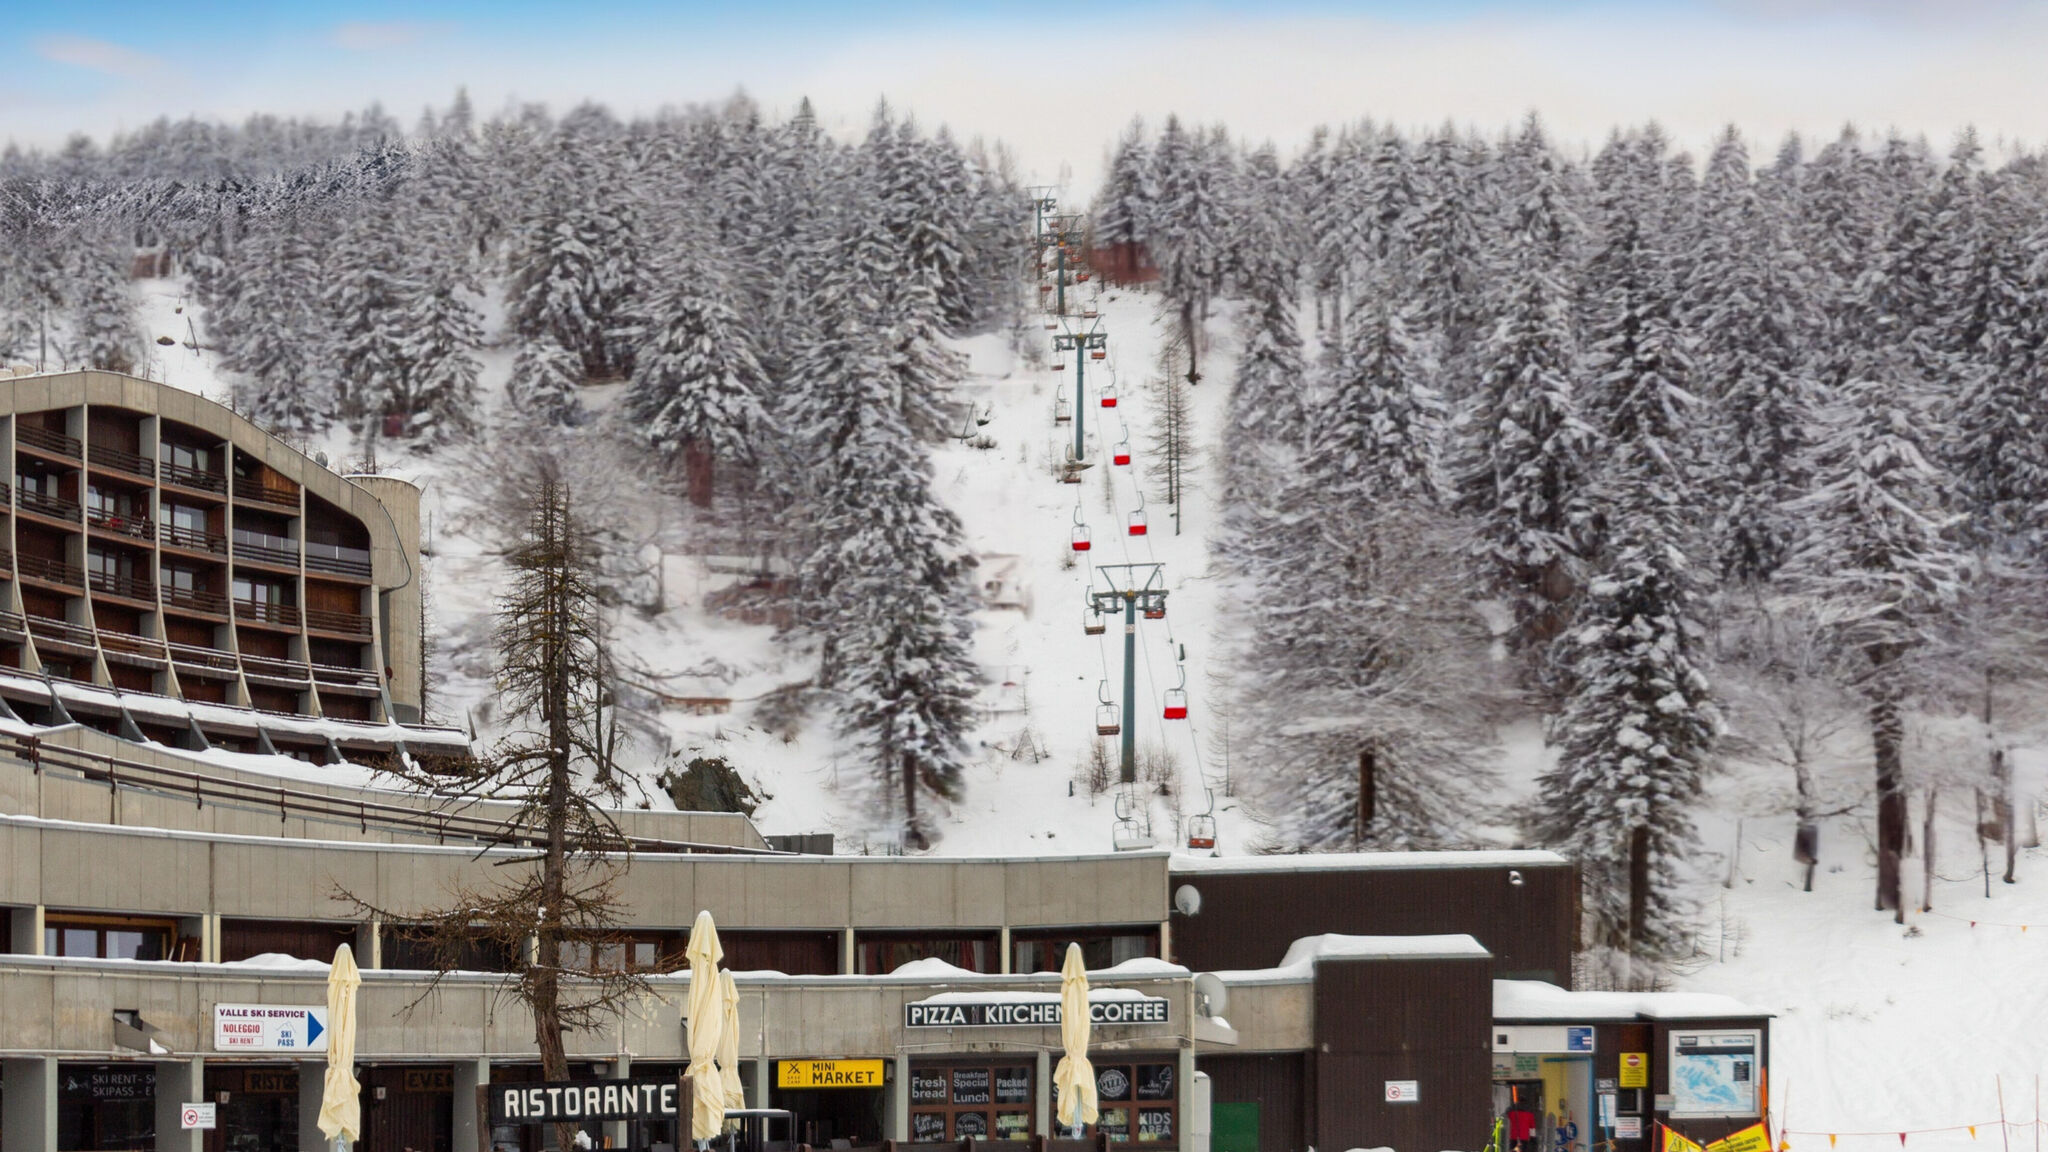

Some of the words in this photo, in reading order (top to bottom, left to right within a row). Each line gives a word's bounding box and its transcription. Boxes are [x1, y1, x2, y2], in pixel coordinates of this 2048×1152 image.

[219, 1009, 248, 1017] VALLE
[250, 1009, 266, 1017] SKI
[267, 1010, 305, 1018] SERVICE
[911, 1006, 966, 1024] PIZZA
[1090, 1003, 1164, 1021] COFFEE
[223, 1023, 260, 1034] NOLEGGIO
[281, 1030, 292, 1038] SKI
[277, 1039, 295, 1047] PASS
[812, 1062, 835, 1071] MINI
[92, 1074, 108, 1084] SKI
[812, 1071, 875, 1084] MARKET
[912, 1075, 947, 1087] Fresh
[996, 1078, 1027, 1087] Packed
[953, 1078, 989, 1088] Special
[92, 1087, 135, 1097] SKIPASS
[912, 1087, 947, 1098] bread
[504, 1084, 677, 1118] RISTORANTE
[953, 1092, 989, 1103] Lunch
[1139, 1112, 1171, 1125] KIDS
[1139, 1125, 1171, 1135] AREA
